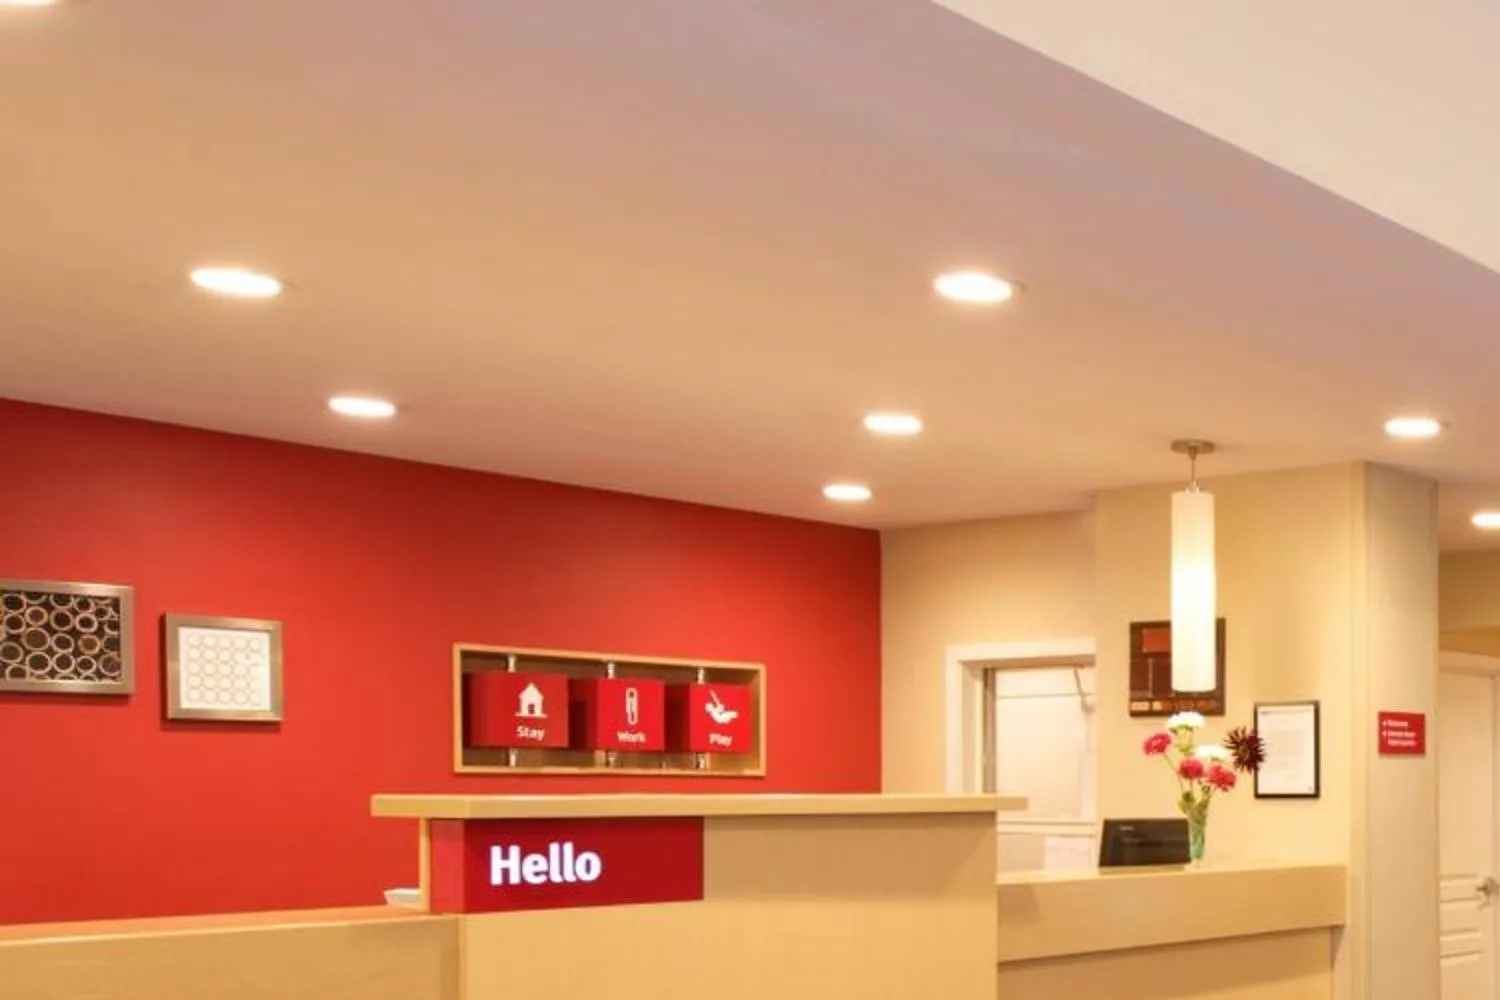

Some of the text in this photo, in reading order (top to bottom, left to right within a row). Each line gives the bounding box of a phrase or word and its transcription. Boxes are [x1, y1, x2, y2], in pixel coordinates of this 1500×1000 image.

[516, 725, 545, 741] Stay
[617, 730, 647, 744] Work
[709, 732, 733, 747] Play
[489, 841, 602, 886] Hello
